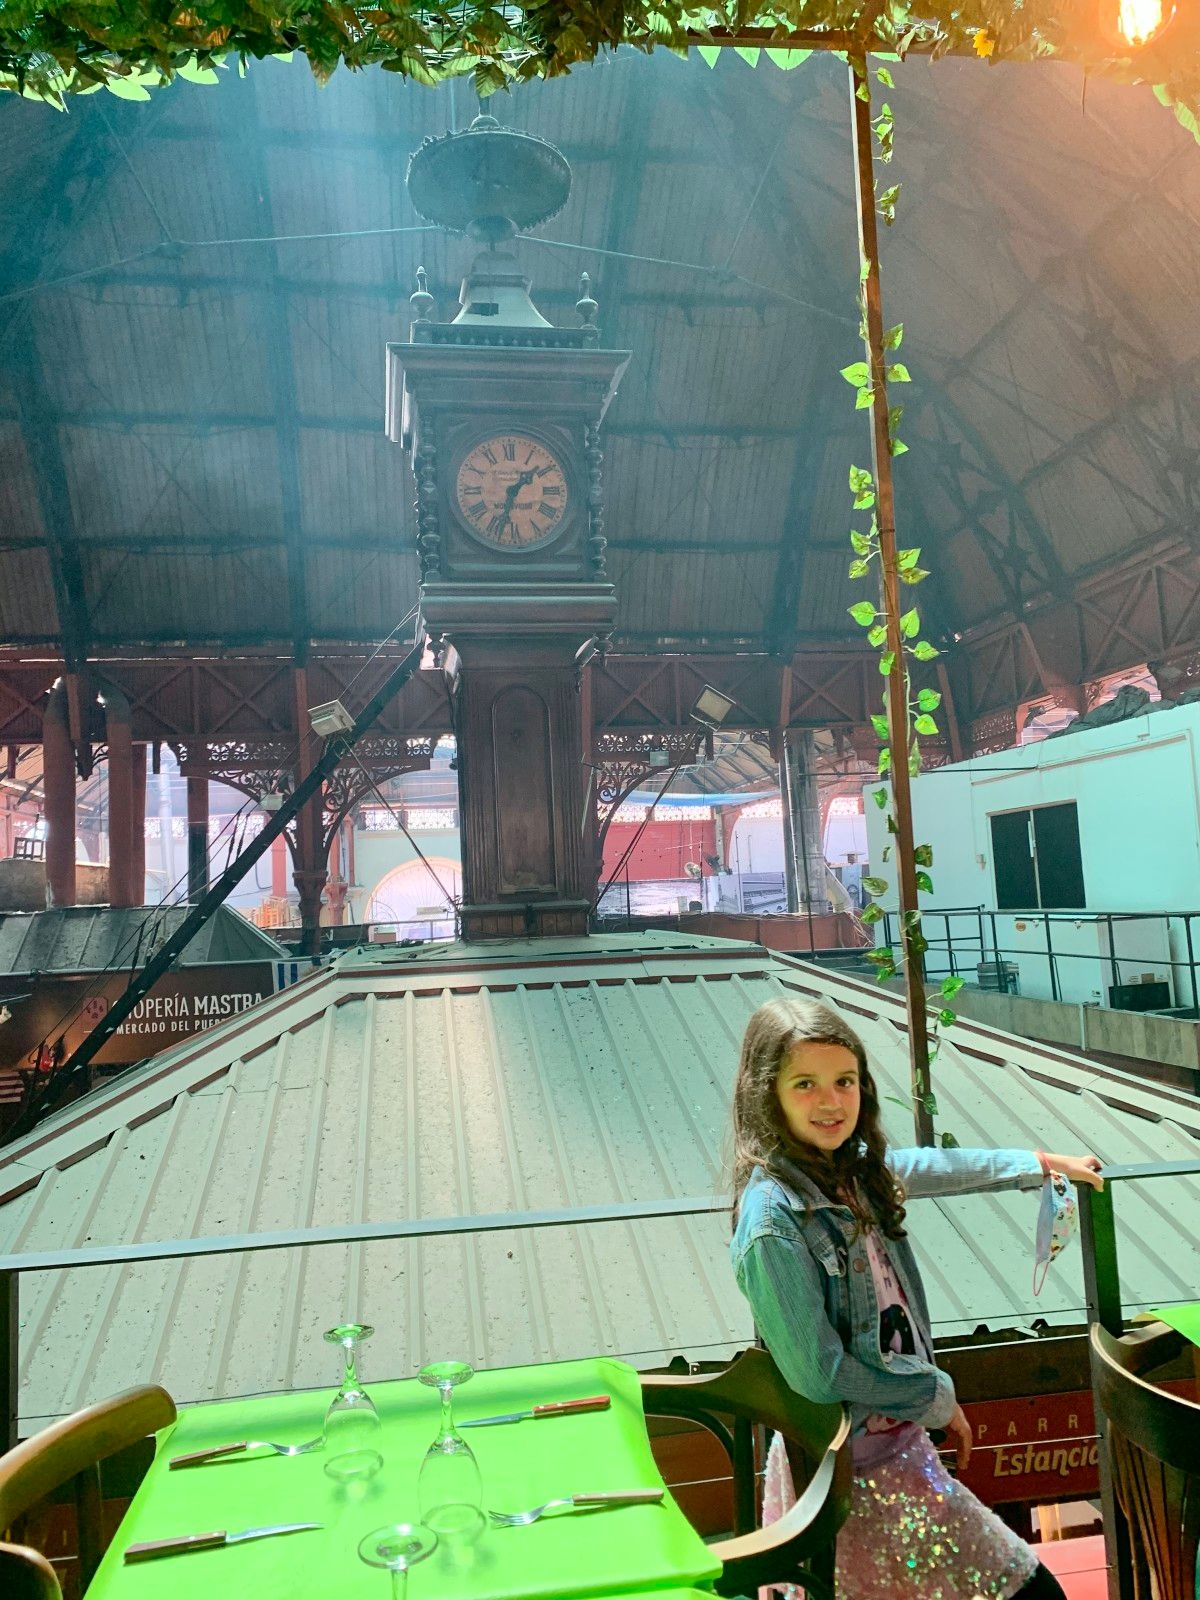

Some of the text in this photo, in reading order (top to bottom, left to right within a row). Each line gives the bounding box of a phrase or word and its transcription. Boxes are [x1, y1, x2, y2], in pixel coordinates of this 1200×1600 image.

[112, 992, 190, 1020] OPERÍA
[116, 1021, 166, 1035] MERCADO
[171, 1020, 190, 1032] DEL
